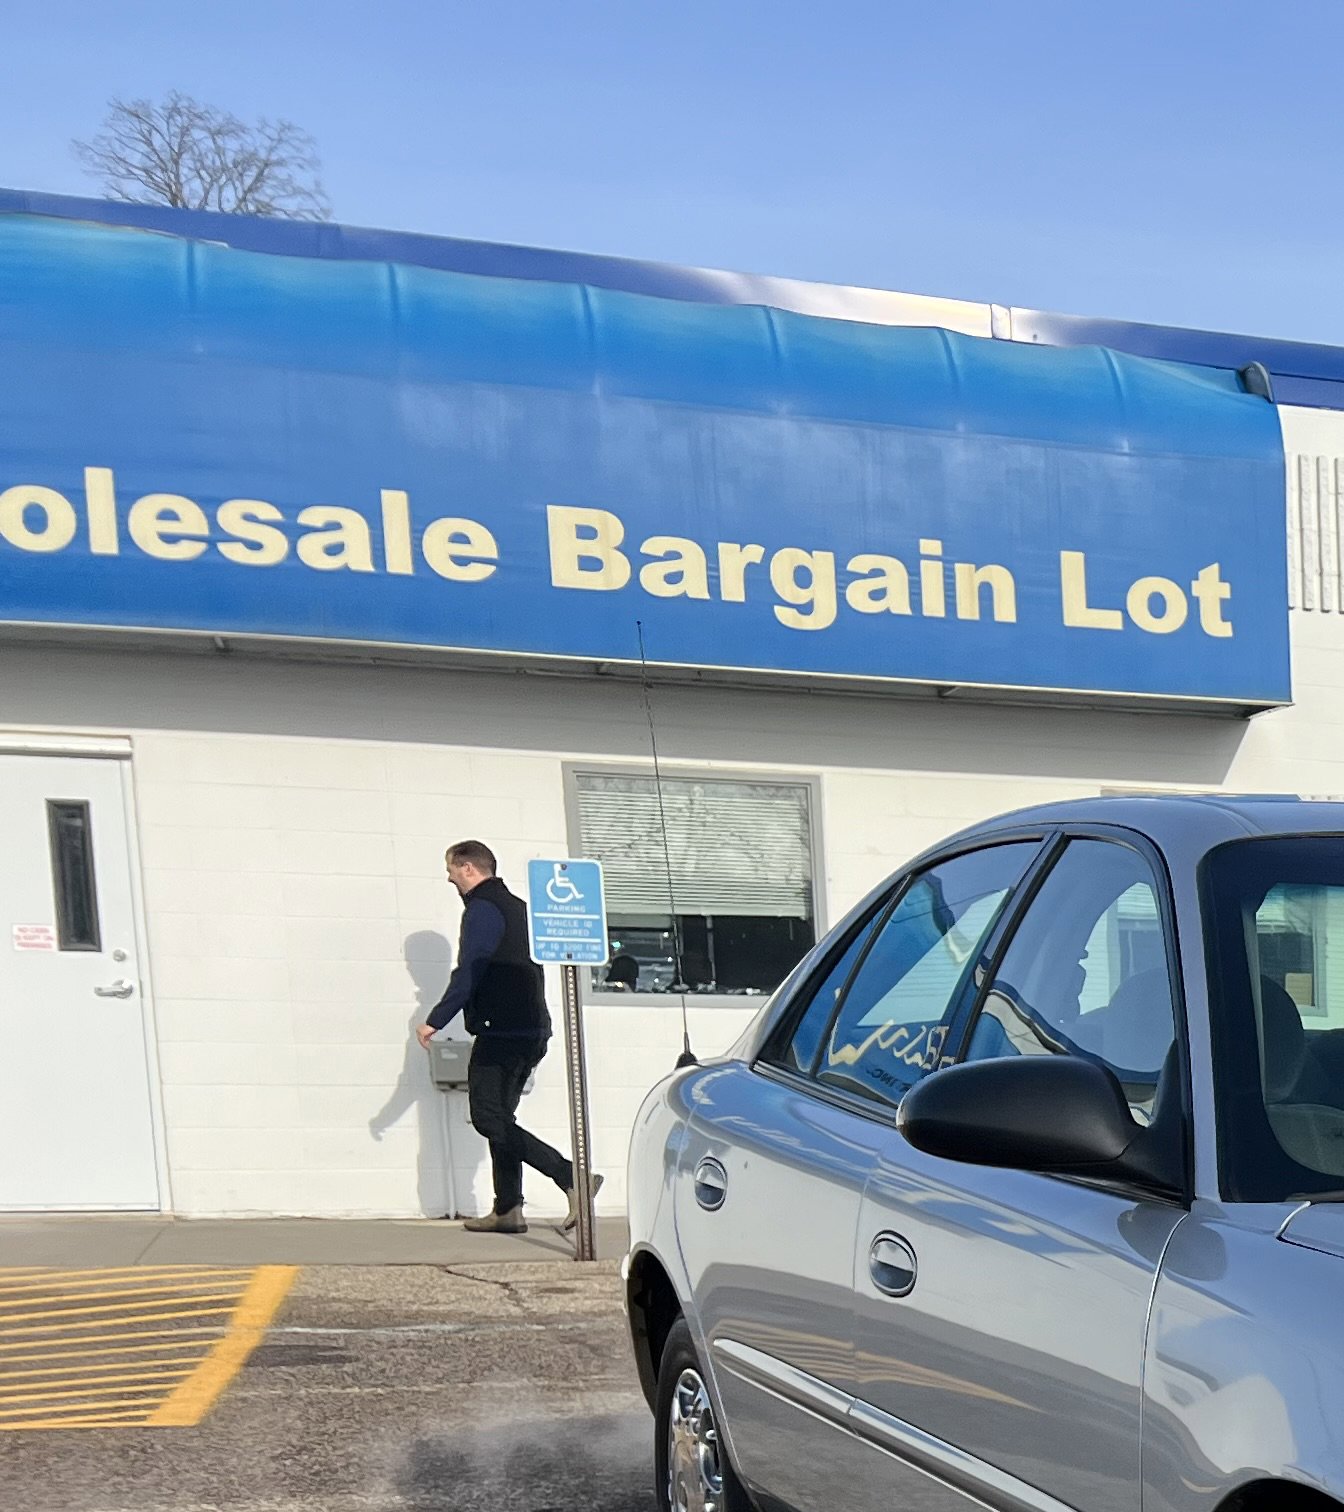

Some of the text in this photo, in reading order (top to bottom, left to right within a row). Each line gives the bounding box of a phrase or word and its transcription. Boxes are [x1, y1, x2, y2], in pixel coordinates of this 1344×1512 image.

[0, 466, 1235, 640] olesale Bargain Lot
[547, 904, 586, 913] PARKING
[543, 919, 579, 928] VEHICLE
[546, 928, 590, 937] REQUIRED
